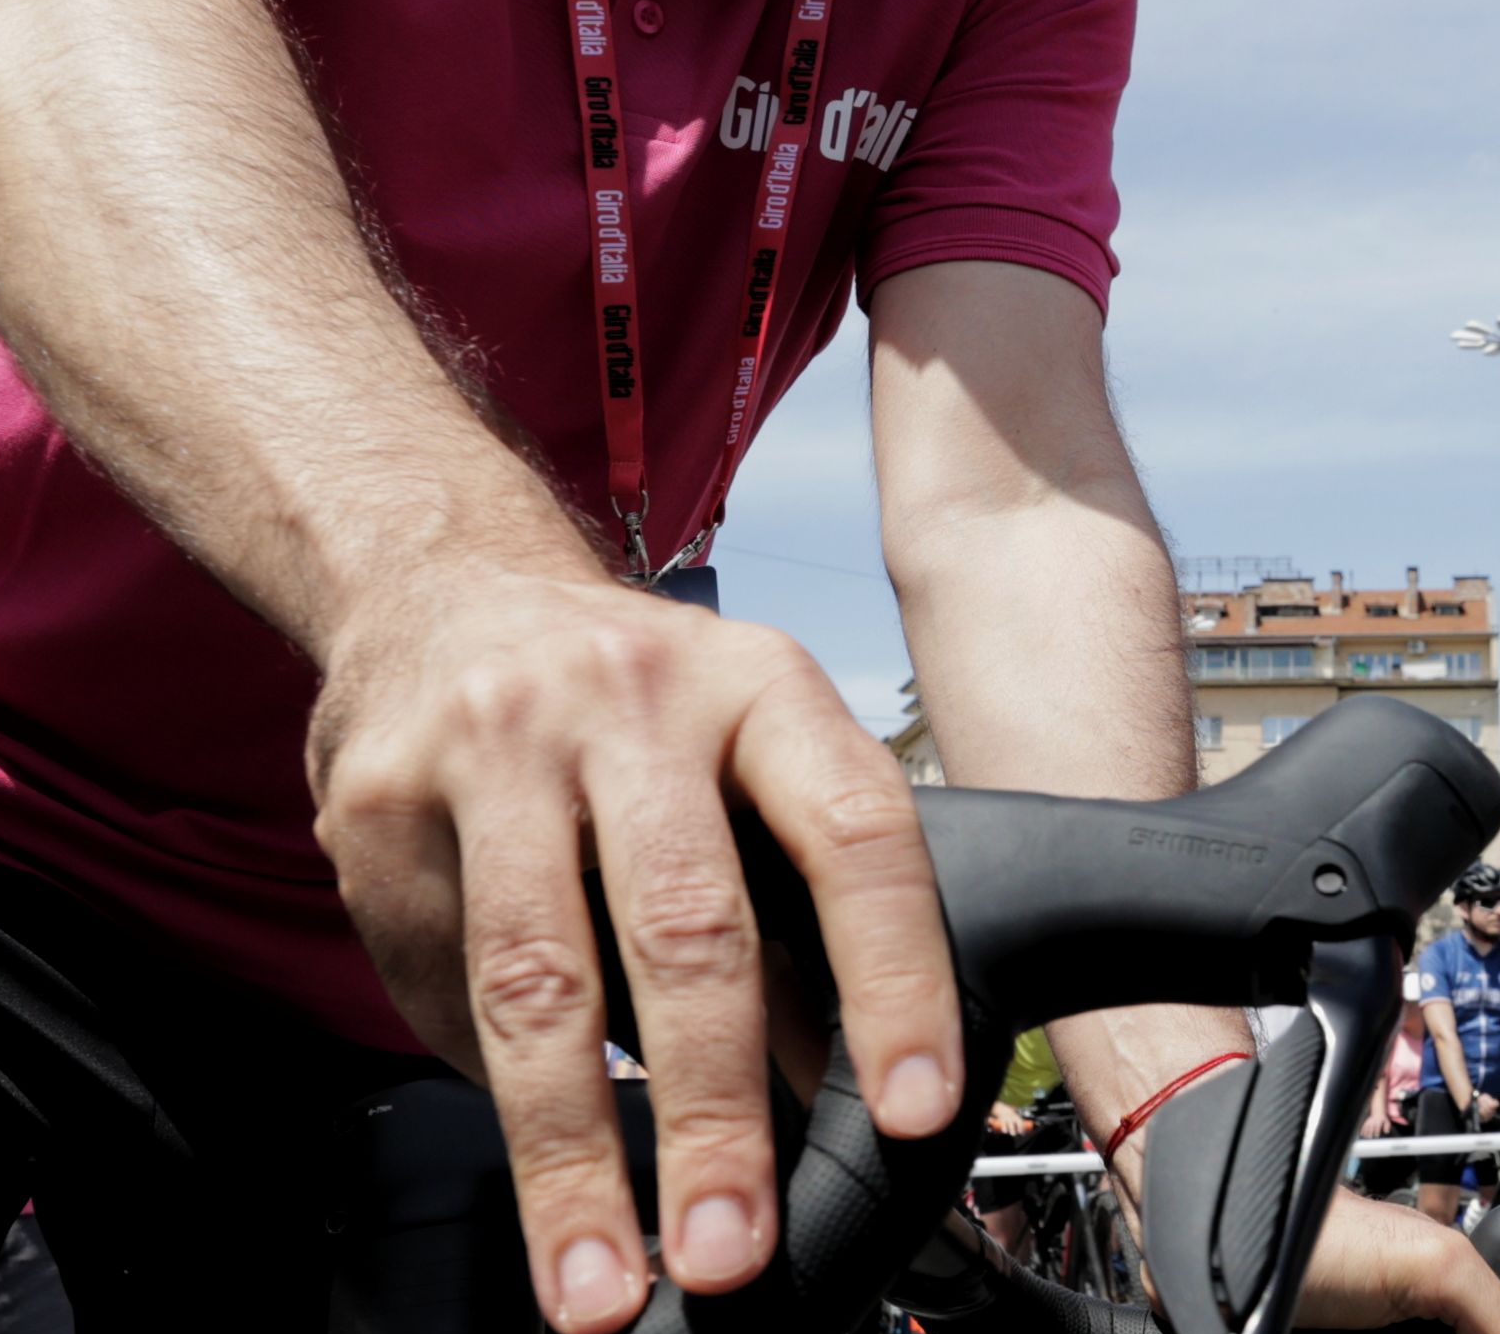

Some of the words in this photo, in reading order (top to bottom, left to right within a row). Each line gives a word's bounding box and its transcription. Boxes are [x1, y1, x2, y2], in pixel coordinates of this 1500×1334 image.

[584, 77, 612, 111] Giro
[719, 75, 780, 152] Gir
[595, 190, 623, 225] Giro
[758, 196, 787, 229] Giro
[603, 304, 632, 340] Giro
[726, 411, 744, 445] Giro
[1128, 826, 1269, 865] SHIMANO
